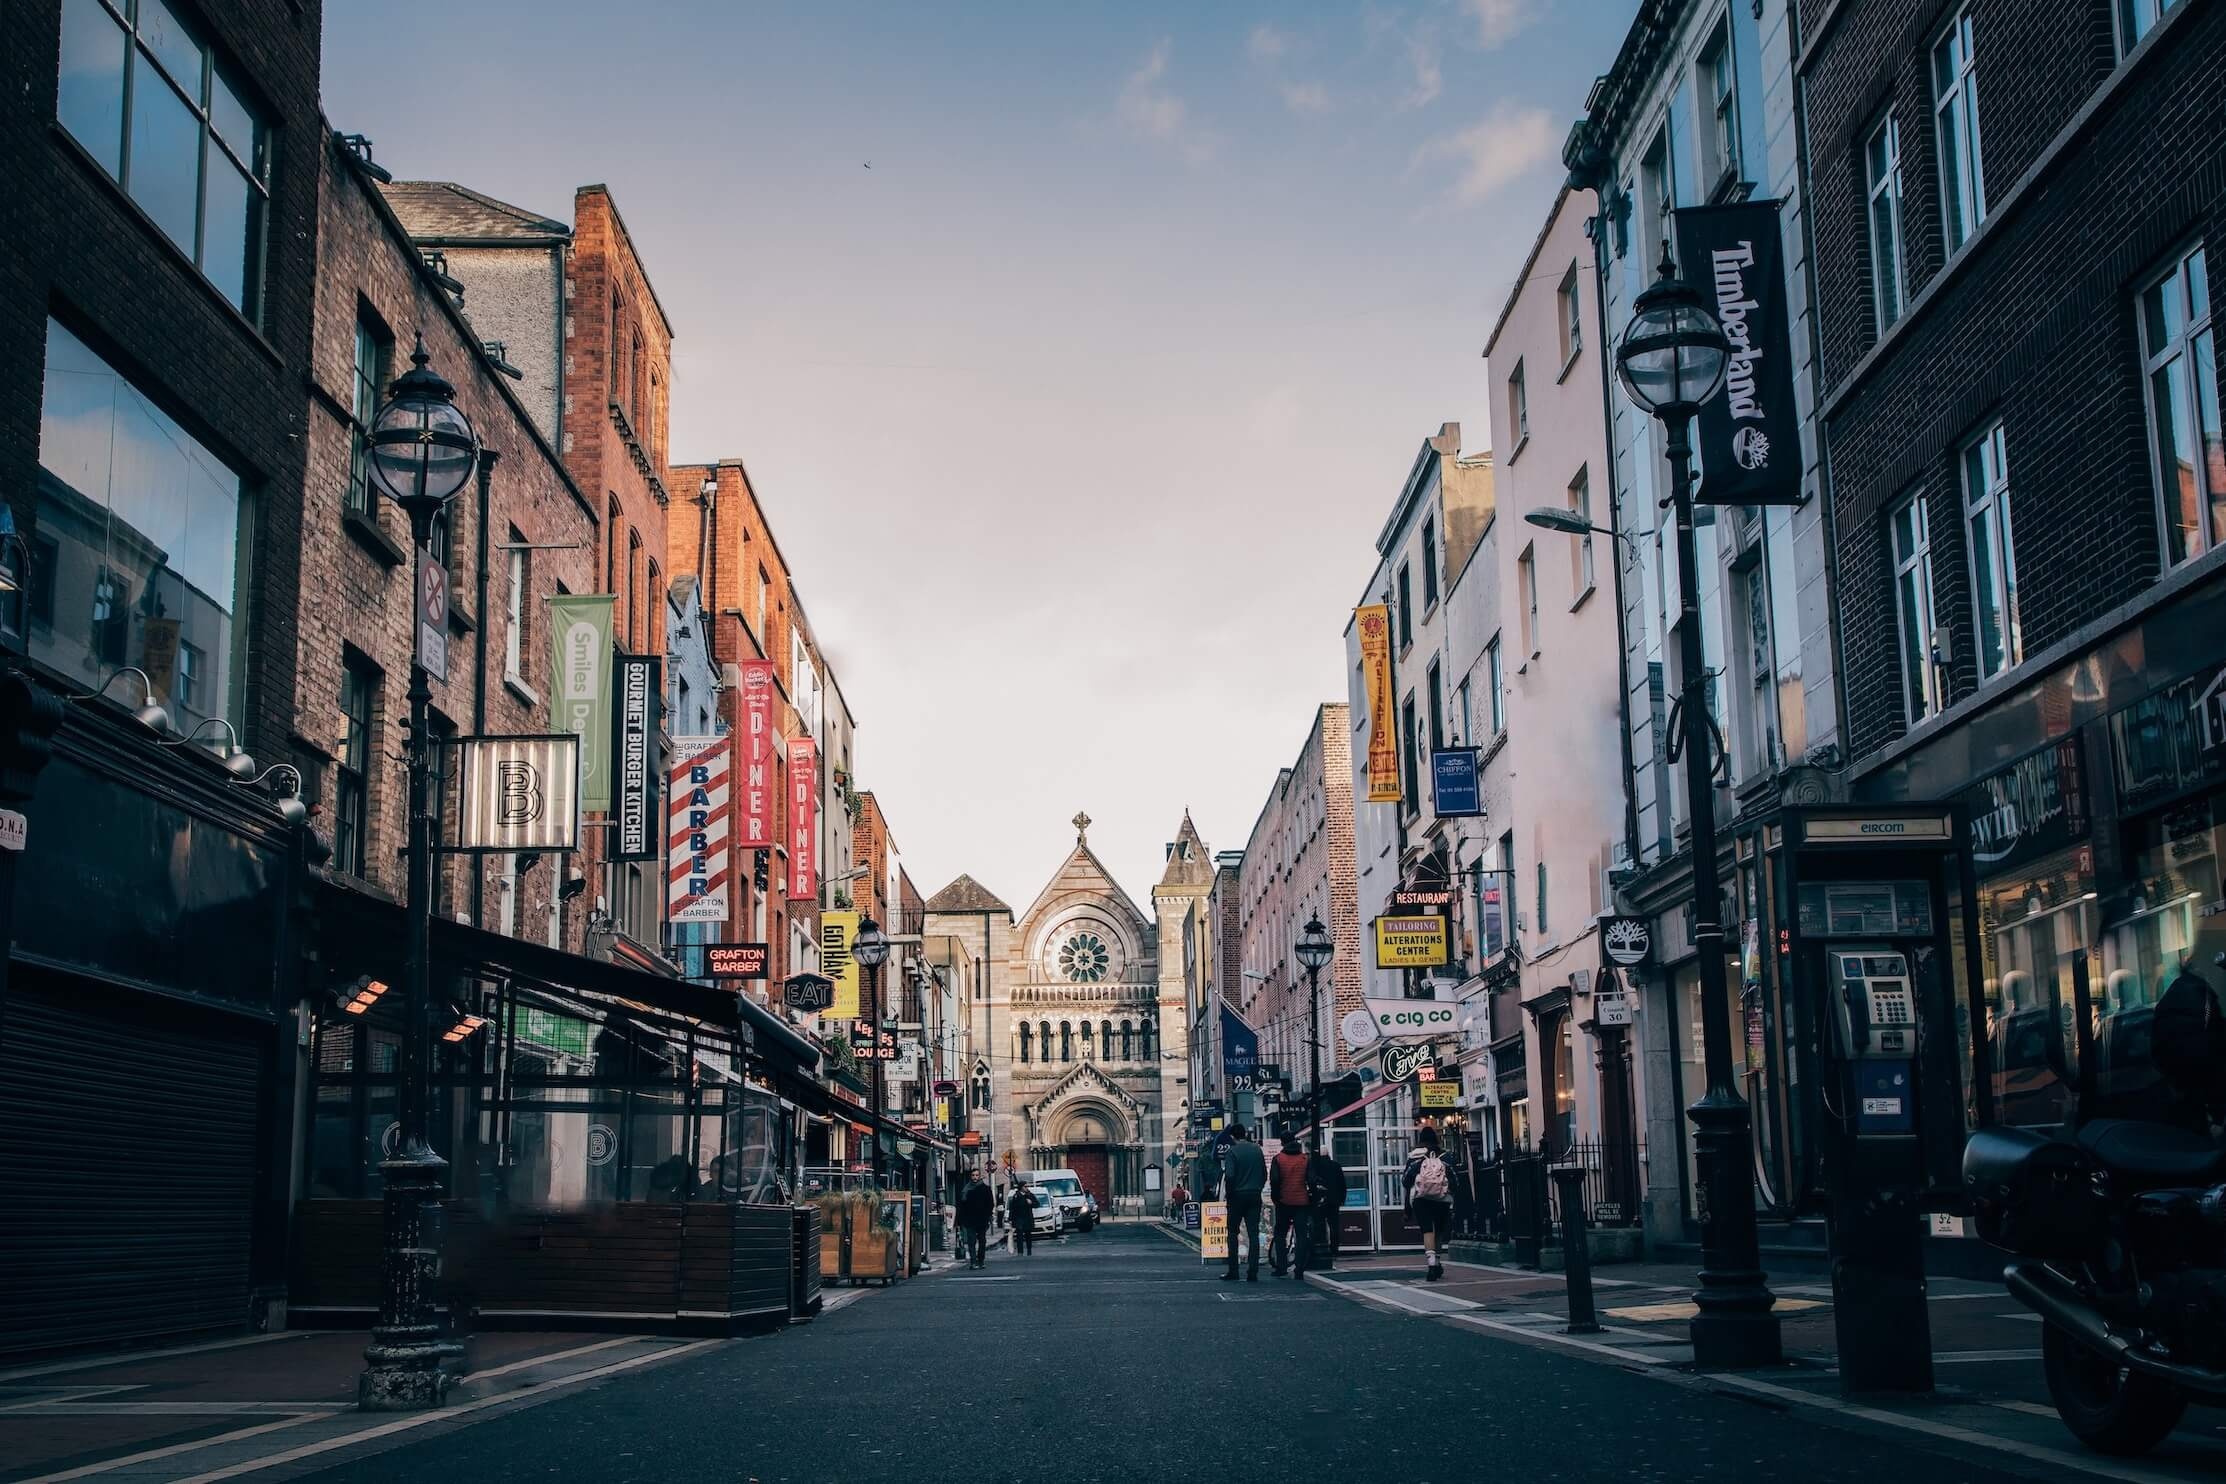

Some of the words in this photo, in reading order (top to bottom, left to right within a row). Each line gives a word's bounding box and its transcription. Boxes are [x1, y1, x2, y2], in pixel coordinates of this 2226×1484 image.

[1711, 240, 1765, 420] Timberland
[573, 632, 592, 693] Smiles
[626, 662, 645, 730] GOURMET
[684, 742, 725, 751] GRAFTON
[626, 733, 643, 788] BURGER
[749, 711, 763, 841] DINER
[1437, 765, 1472, 774] CHIFFON
[497, 760, 545, 826] B
[625, 792, 642, 854] KITCHEN
[688, 765, 711, 897] BARBER
[796, 783, 808, 894] DINER
[683, 898, 724, 907] GRAFTON
[1397, 892, 1449, 904] RESTAURANT
[683, 909, 720, 917] BARBER
[1388, 921, 1436, 931] TAILORING
[1384, 935, 1442, 945] ALTERATIONS
[709, 949, 765, 960] GRAFTON
[1396, 946, 1430, 956] CENTRE
[712, 961, 761, 972] BARBER
[785, 981, 831, 1006] EAT
[1379, 1014, 1391, 1026] e
[1395, 1011, 1425, 1027] cig
[1428, 1010, 1452, 1022] co
[1608, 1014, 1622, 1022] 30
[1382, 1044, 1435, 1083] Cave
[1234, 1075, 1253, 1091] 22
[1419, 1073, 1436, 1081] BAR
[1217, 1143, 1231, 1154] 22
